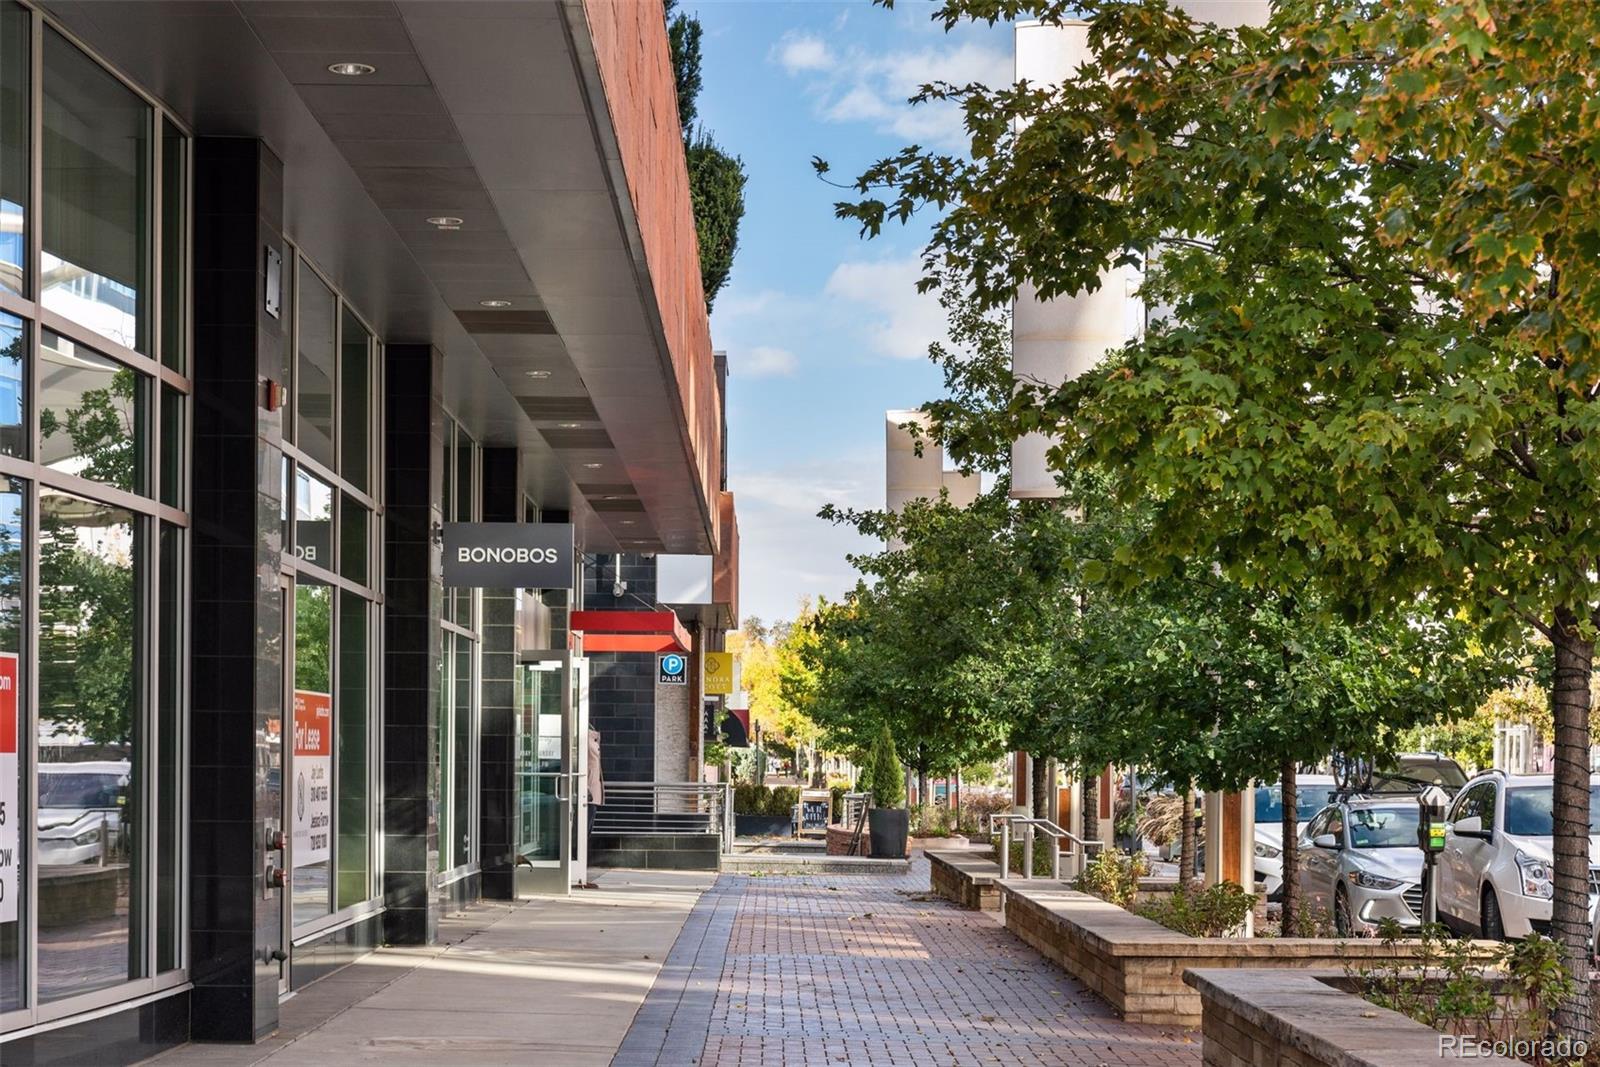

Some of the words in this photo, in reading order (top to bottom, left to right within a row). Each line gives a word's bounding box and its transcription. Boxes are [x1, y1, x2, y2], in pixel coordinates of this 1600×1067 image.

[458, 547, 558, 563] BONOBOS
[294, 720, 304, 750] For
[304, 721, 320, 750] Lease
